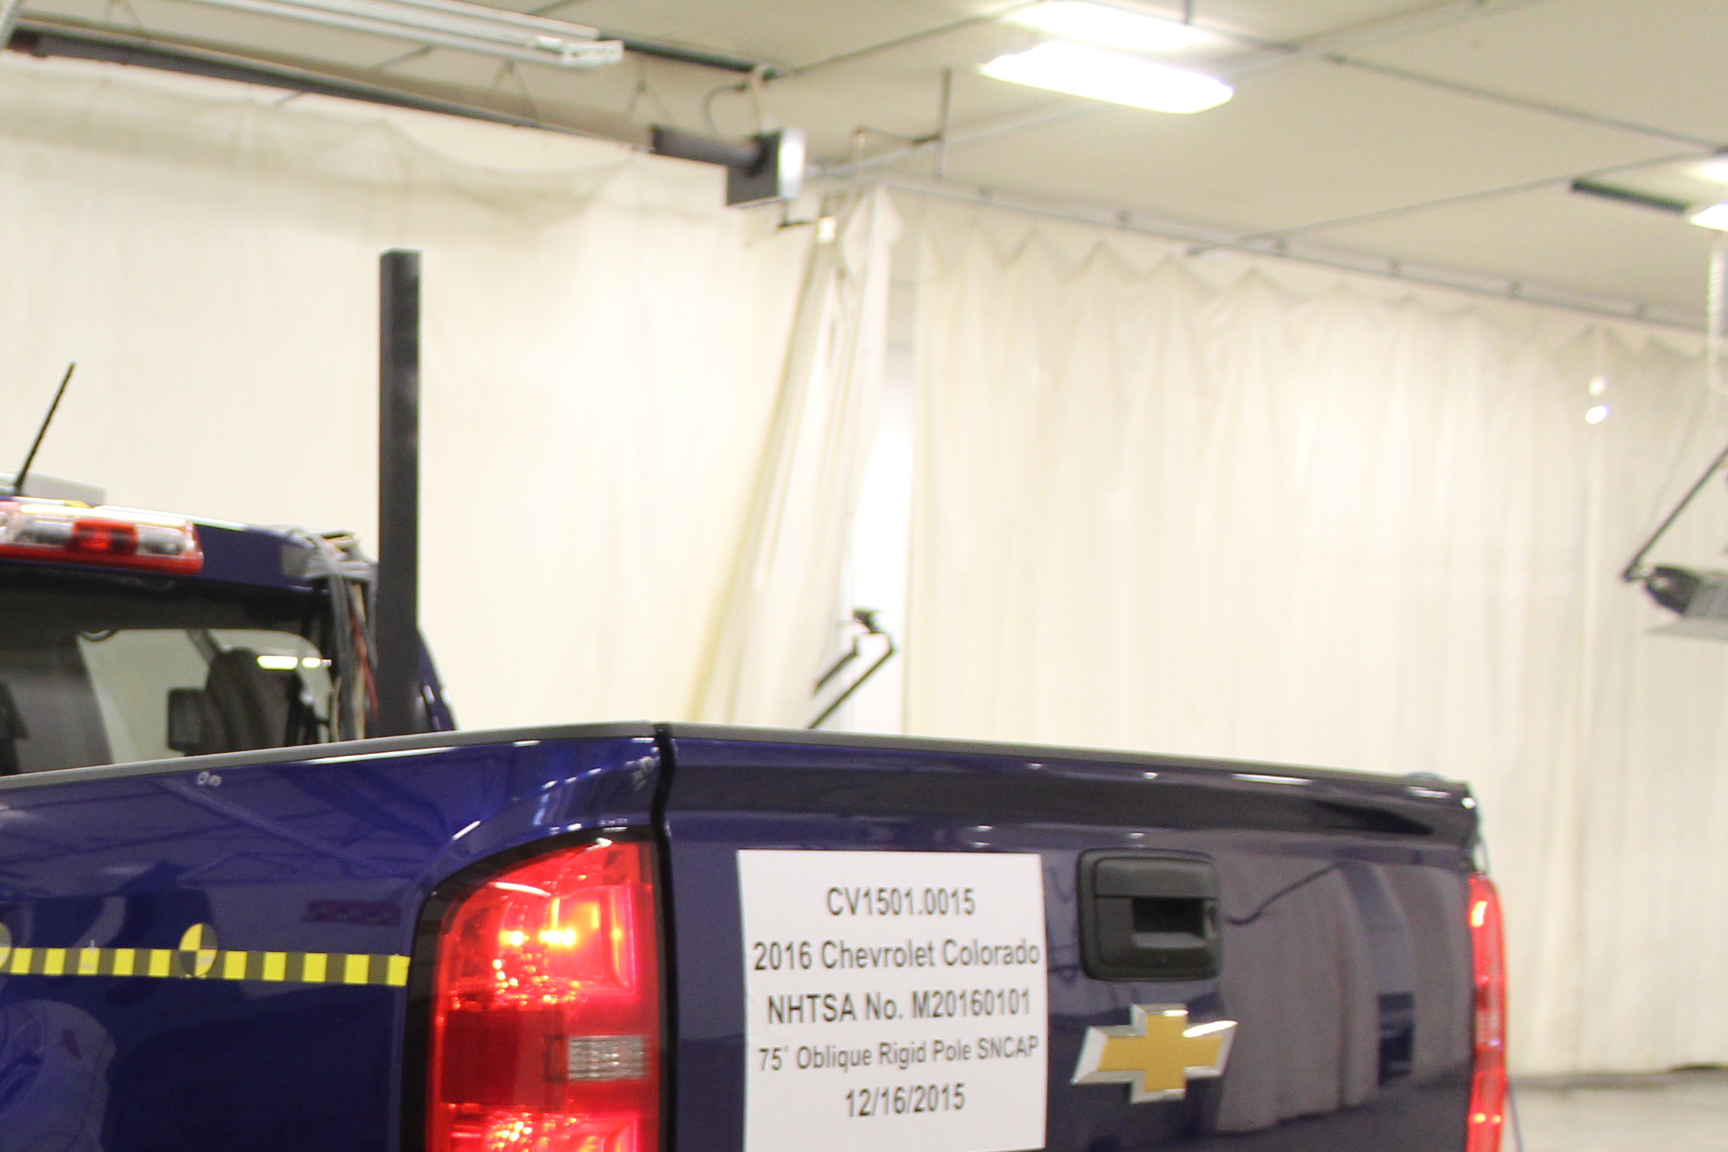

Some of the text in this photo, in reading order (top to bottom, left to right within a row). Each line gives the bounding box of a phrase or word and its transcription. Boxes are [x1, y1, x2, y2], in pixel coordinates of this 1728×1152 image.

[826, 887, 976, 917] CV1501.0015
[754, 937, 1040, 971] 2016 Chevrolet Colorado
[768, 987, 1031, 1025] NHTSA No. M20160101
[797, 1043, 873, 1074] Oblique
[879, 1040, 927, 1070] Rigid
[933, 1038, 972, 1062] Pole
[978, 1034, 1040, 1060] SNCAP
[845, 1082, 966, 1118] 12/16/2015
